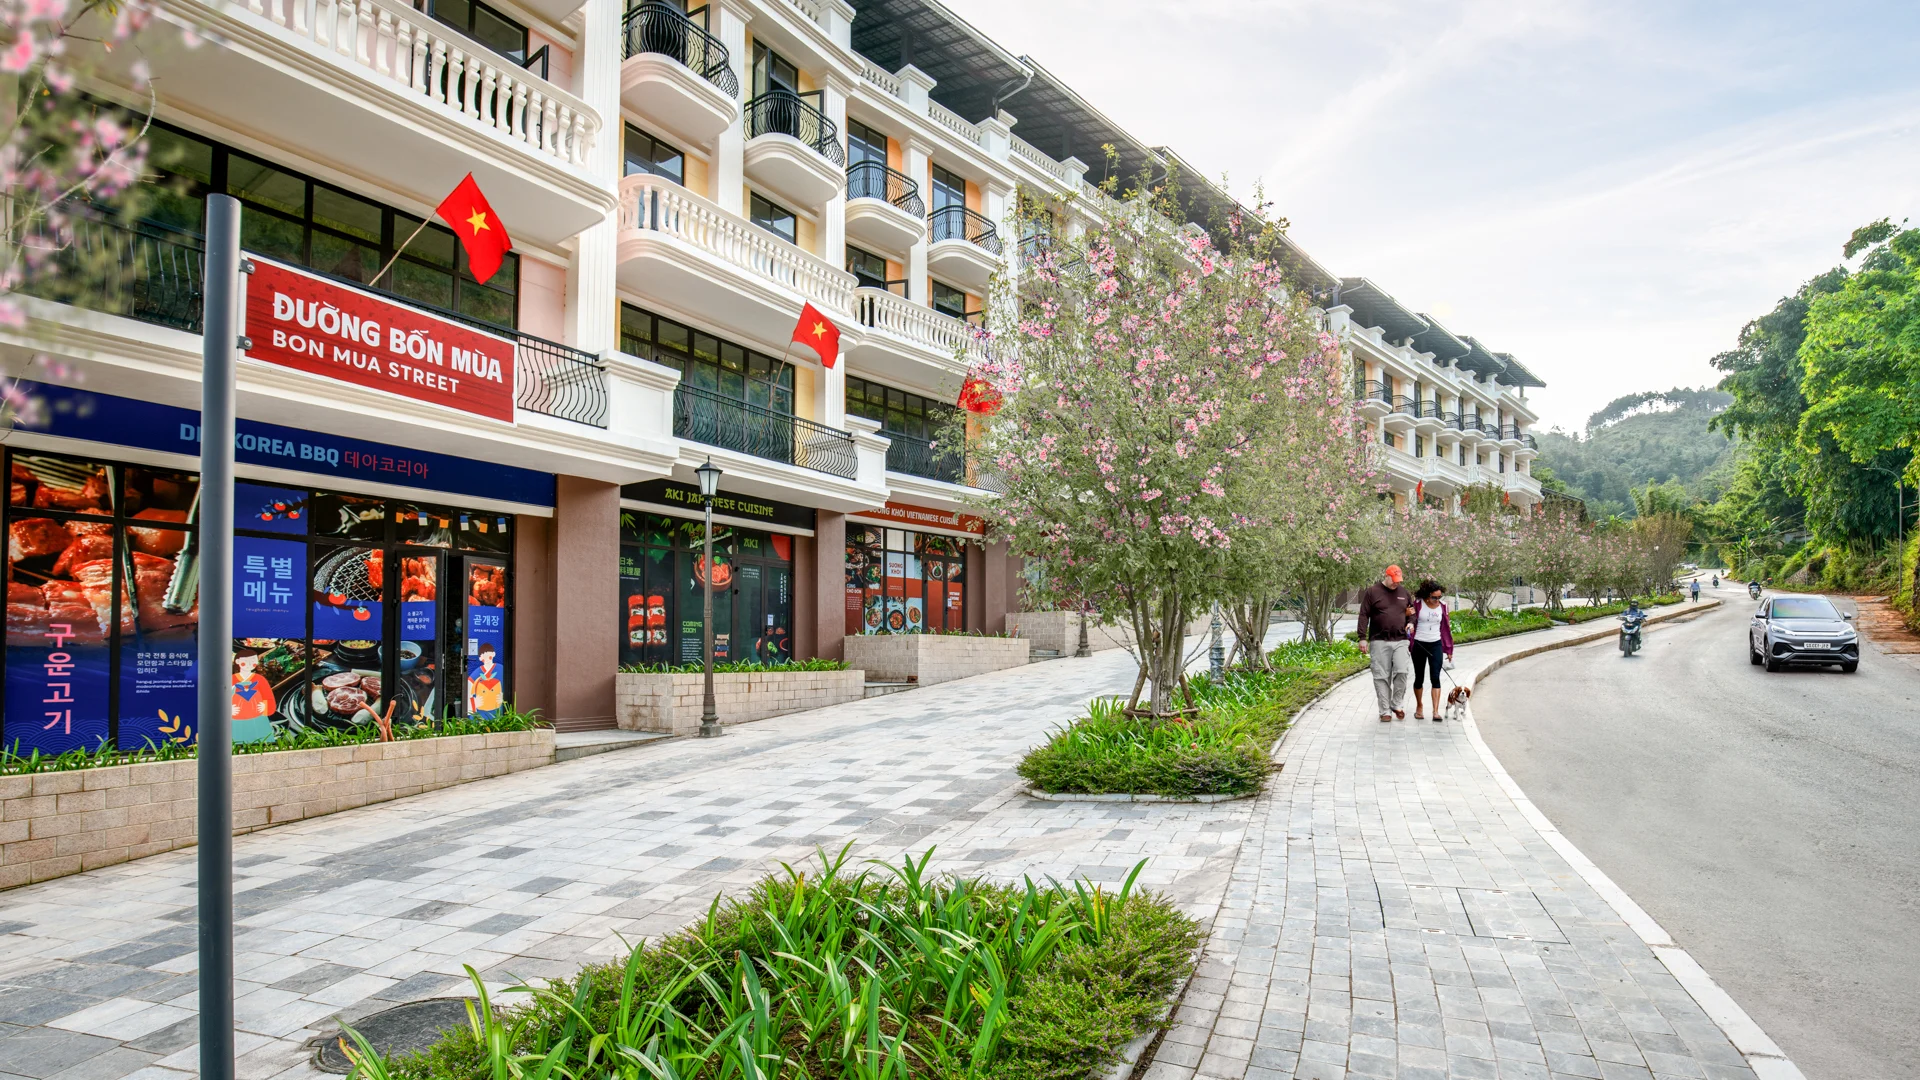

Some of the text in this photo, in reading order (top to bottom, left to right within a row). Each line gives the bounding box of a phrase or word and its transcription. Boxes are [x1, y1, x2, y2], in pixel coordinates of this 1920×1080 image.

[272, 291, 503, 384] ĐƯỜNG BỐN MÙA
[273, 329, 460, 394] BON MUA STREET
[300, 443, 339, 468] BBQ
[344, 450, 429, 479] 데아코리아
[665, 487, 774, 517] AKI JAPNESE CUISINE
[906, 510, 939, 523] VIETNAMESE
[939, 515, 959, 526] CUISINE
[743, 538, 759, 549] AKI
[243, 555, 293, 580] 특별
[243, 581, 293, 605] 메뉴
[473, 614, 499, 627] 곧개장
[43, 623, 76, 735] 구운고기
